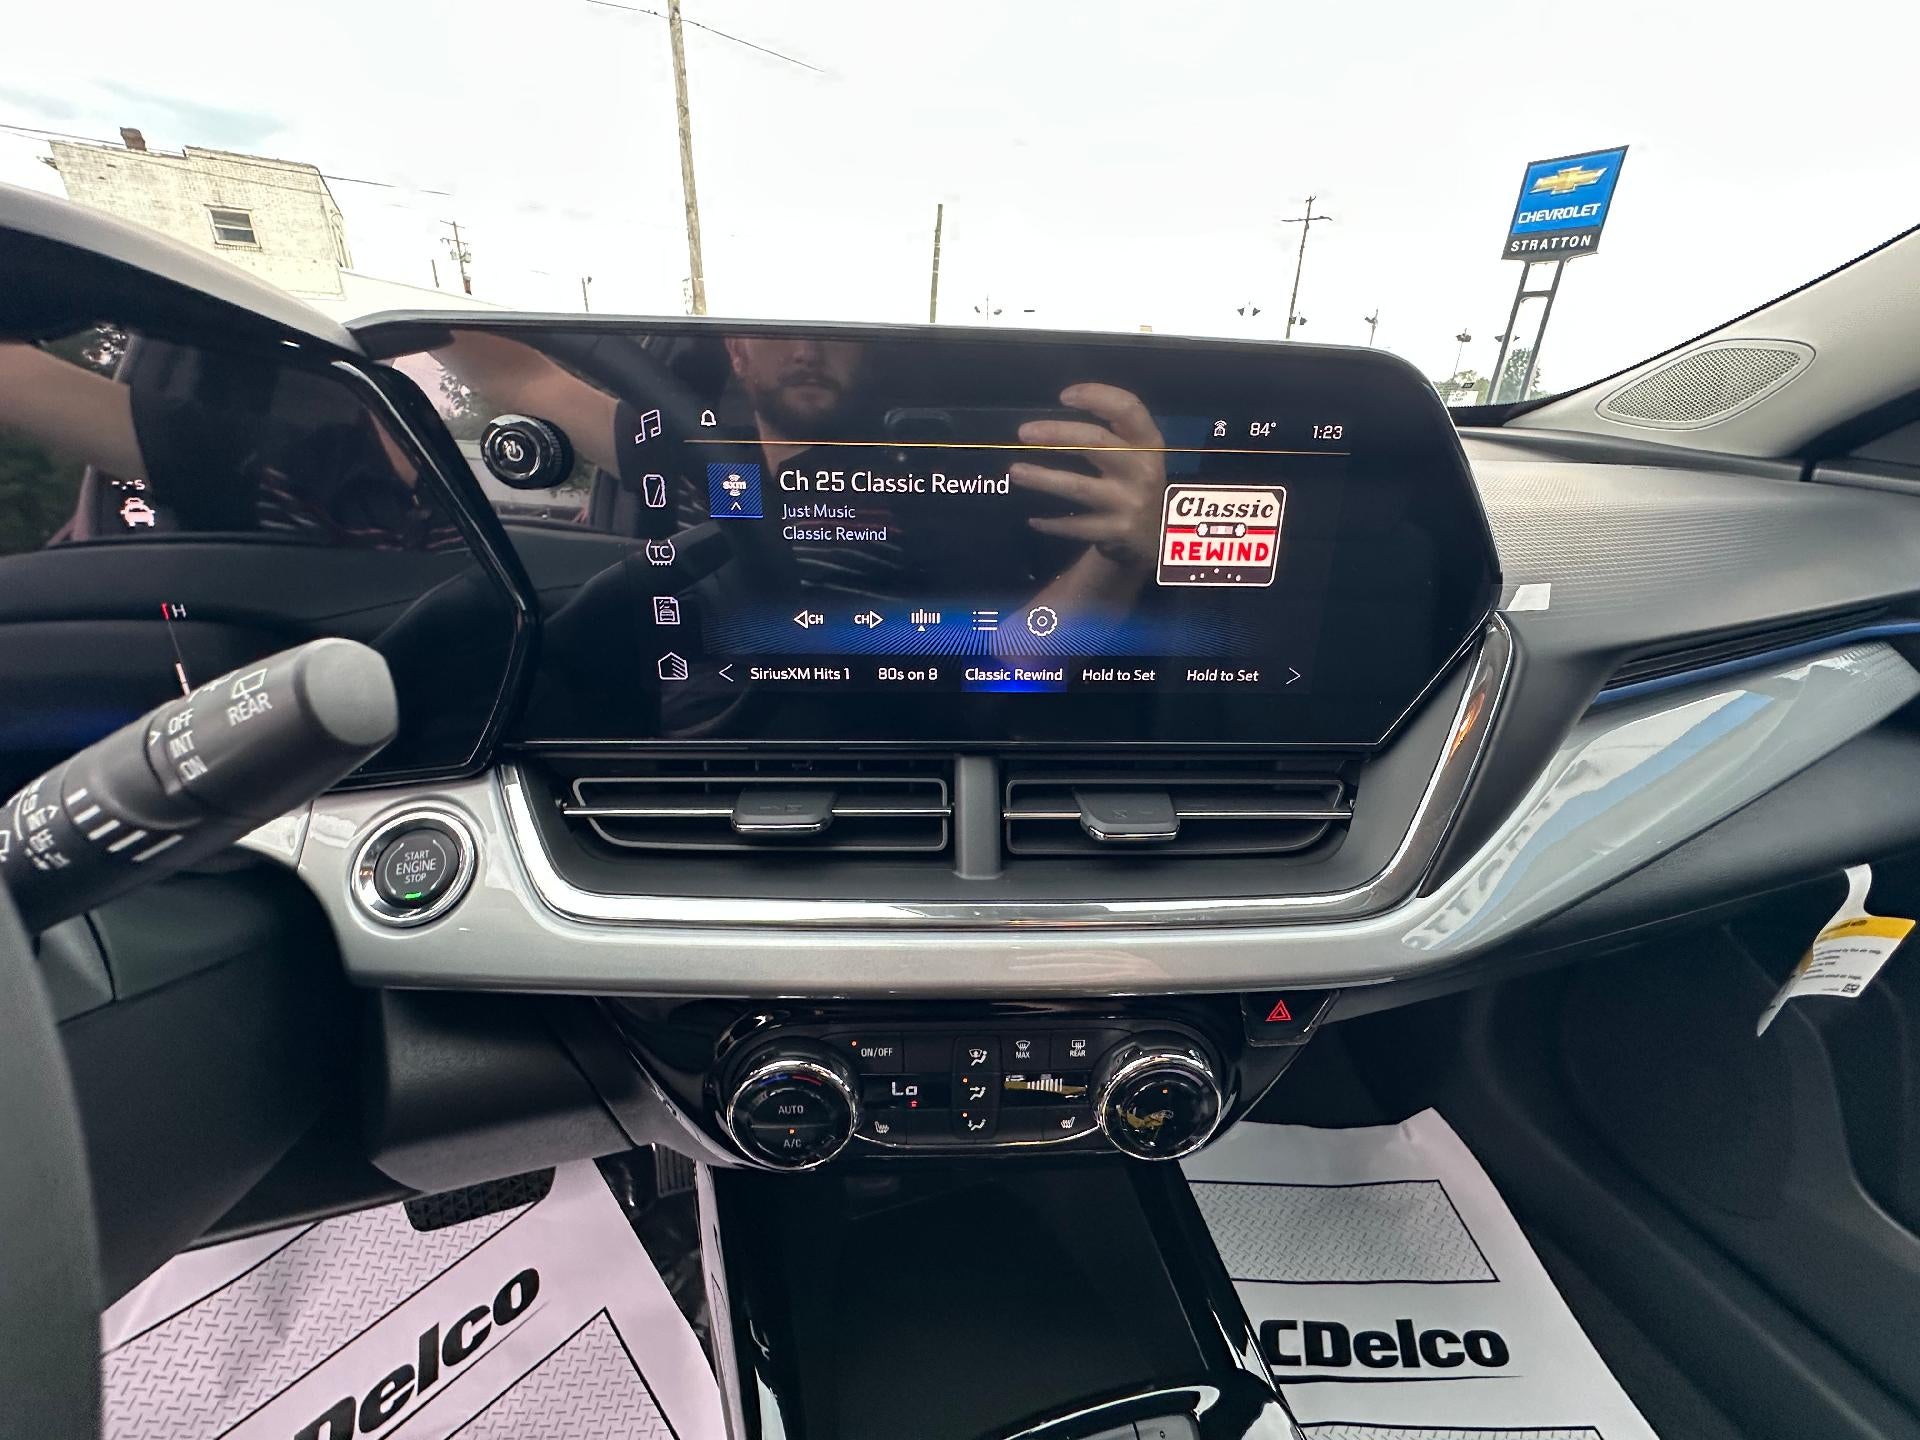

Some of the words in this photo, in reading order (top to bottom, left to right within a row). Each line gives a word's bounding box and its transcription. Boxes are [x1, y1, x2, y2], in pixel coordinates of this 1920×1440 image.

[1518, 203, 1601, 224] CHEVROLET
[1510, 235, 1592, 252] STRATTON
[1249, 422, 1277, 437] 84°
[1311, 425, 1344, 441] 1:23
[779, 469, 810, 492] Ch
[815, 471, 846, 492] 25
[851, 471, 926, 494] Classic
[931, 472, 1011, 495] Rewind
[782, 503, 811, 520] Just
[813, 503, 856, 519] Music
[1175, 497, 1275, 519] Classic
[782, 526, 832, 542] Classic
[835, 526, 888, 542] Rewind
[650, 545, 671, 558] TC
[1170, 541, 1269, 561] REWIND
[808, 613, 824, 625] CH
[854, 613, 870, 625] CH
[750, 666, 811, 681] SiriusXM
[814, 667, 841, 681] Hits
[843, 667, 850, 681] 1
[877, 668, 905, 682] 80s
[907, 671, 926, 682] on
[928, 668, 939, 682] 8
[964, 669, 1012, 683] Classic
[1014, 669, 1063, 683] Rewind
[1082, 669, 1113, 682] Hold
[1117, 670, 1129, 682] to
[1134, 669, 1156, 682] Set
[1186, 669, 1217, 683] Hold
[1220, 670, 1233, 683] to
[1237, 669, 1259, 683] Set
[227, 692, 272, 727] REAR
[167, 707, 194, 736] OFF
[169, 730, 195, 759] INT
[179, 755, 209, 781] ON
[404, 849, 430, 861] START
[395, 858, 437, 876] ENGINE
[404, 872, 427, 884] STOP
[860, 1047, 893, 1057] ON/OFF
[1015, 1051, 1031, 1059] MAX
[777, 1105, 804, 1115] AUTO
[783, 1139, 801, 1149] A/C
